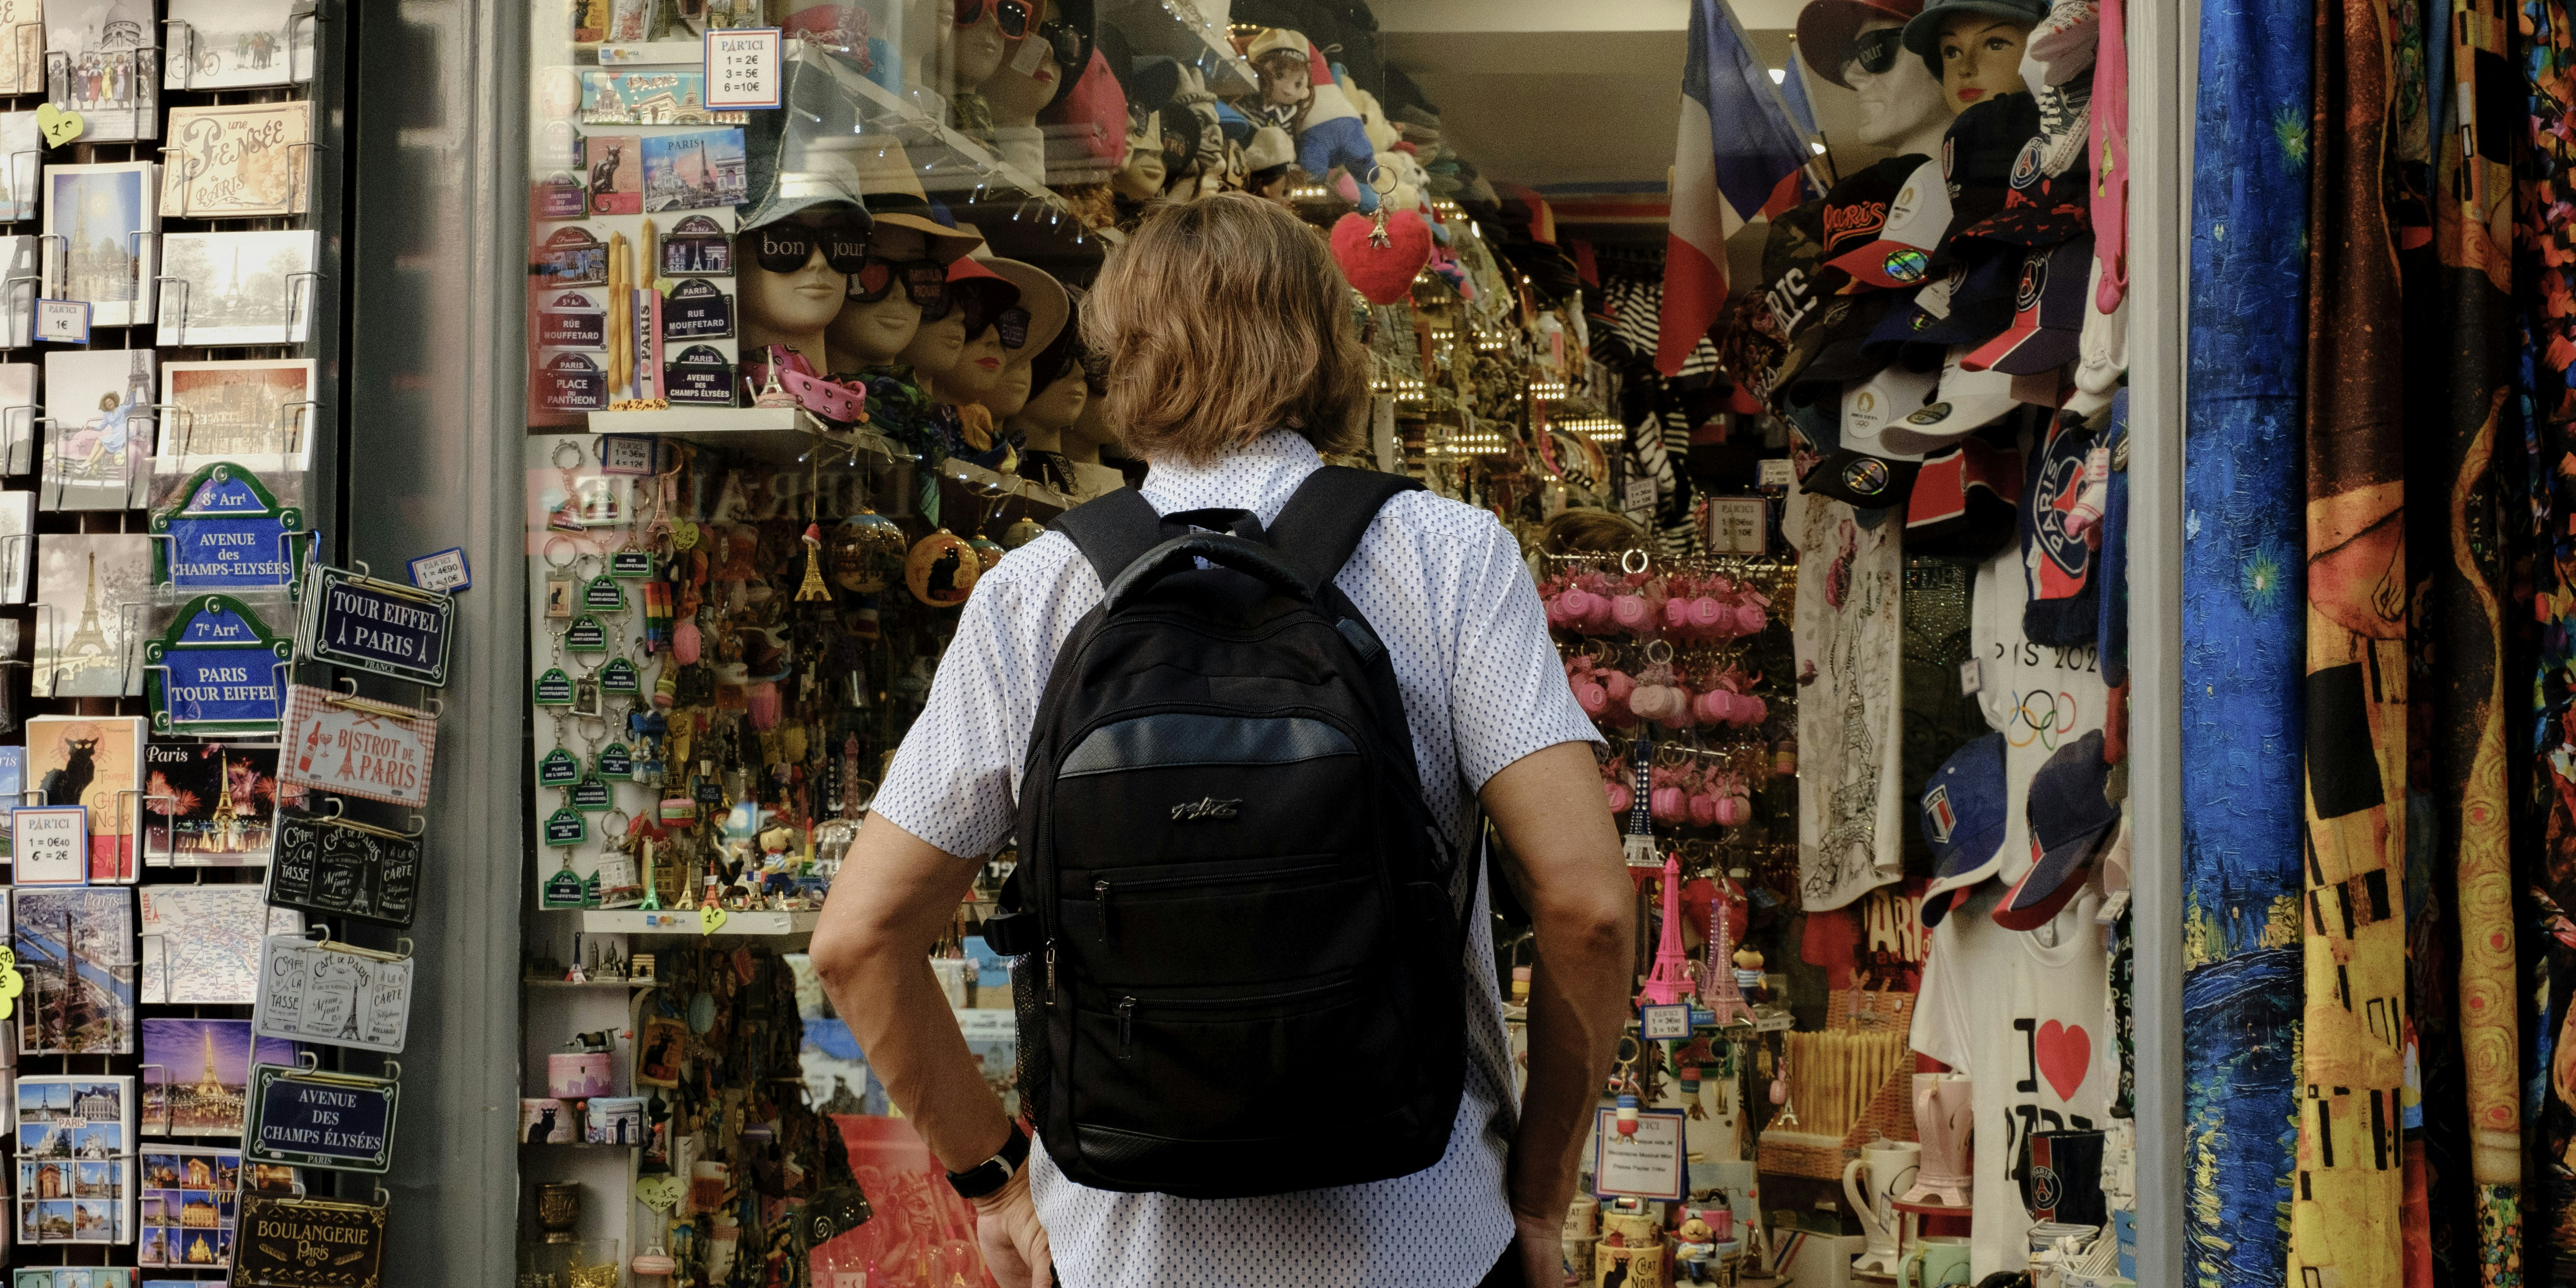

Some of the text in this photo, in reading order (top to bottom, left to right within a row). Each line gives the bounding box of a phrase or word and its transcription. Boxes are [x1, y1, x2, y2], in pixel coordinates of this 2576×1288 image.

[727, 56, 732, 65] 1
[745, 55, 758, 65] 2€
[726, 69, 732, 79] 3
[745, 69, 758, 78] 5€
[626, 74, 679, 93] PARIS
[724, 83, 731, 92] 6
[228, 119, 248, 131] une
[668, 139, 700, 151] PARIS
[196, 172, 245, 207] PARIS
[685, 221, 710, 233] Paris
[764, 231, 805, 256] bon
[833, 233, 866, 257] jour
[683, 286, 708, 296] PARIS
[848, 273, 865, 296] I
[687, 310, 705, 318] RUE
[56, 319, 68, 329] 1€
[669, 319, 725, 330] MOUFFETARD
[640, 304, 652, 362] PARIS
[560, 361, 584, 370] PARIS
[689, 355, 714, 363] PARIS
[556, 379, 588, 389] PLACE
[686, 374, 715, 382] AVENUE
[670, 389, 700, 398] CHAMPS
[2039, 458, 2064, 553] PARIS
[200, 533, 255, 546] AVENUE
[218, 549, 239, 561] des
[422, 563, 458, 580] 1 4€90
[427, 579, 433, 589] 3
[334, 590, 438, 633] TOUR EIFFEL
[353, 626, 413, 657] PARIS
[365, 660, 395, 674] FRANCE
[199, 668, 247, 683] PARIS
[172, 686, 280, 701] TOUR EIFFEL
[338, 728, 400, 758] BISTROT
[0, 753, 17, 767] ris
[146, 745, 188, 764] Paris
[402, 748, 414, 762] DE
[359, 755, 417, 789] PARIS
[94, 810, 131, 830] NOR
[29, 839, 33, 847] 1
[47, 837, 70, 847] 0€40
[32, 850, 40, 861] 6
[55, 850, 68, 861] 2€
[301, 849, 312, 860] LA
[281, 865, 310, 882] TASSE
[384, 865, 412, 882] CARTE
[83, 890, 120, 908] Paris
[141, 893, 151, 922] PARIS
[292, 977, 302, 988] LA
[271, 994, 299, 1010] TASSE
[374, 989, 402, 1007] CARTE
[2014, 1018, 2039, 1093] I
[299, 1089, 357, 1108] AVENUE
[58, 1118, 86, 1128] PARIS
[312, 1110, 340, 1125] DES
[264, 1125, 381, 1150] CHAMPS ÉLYSÉES
[308, 1155, 332, 1165] PARIS
[2033, 1166, 2053, 1180] PARIS
[209, 1185, 236, 1206] Par
[257, 1220, 369, 1245] BOULANGERIE
